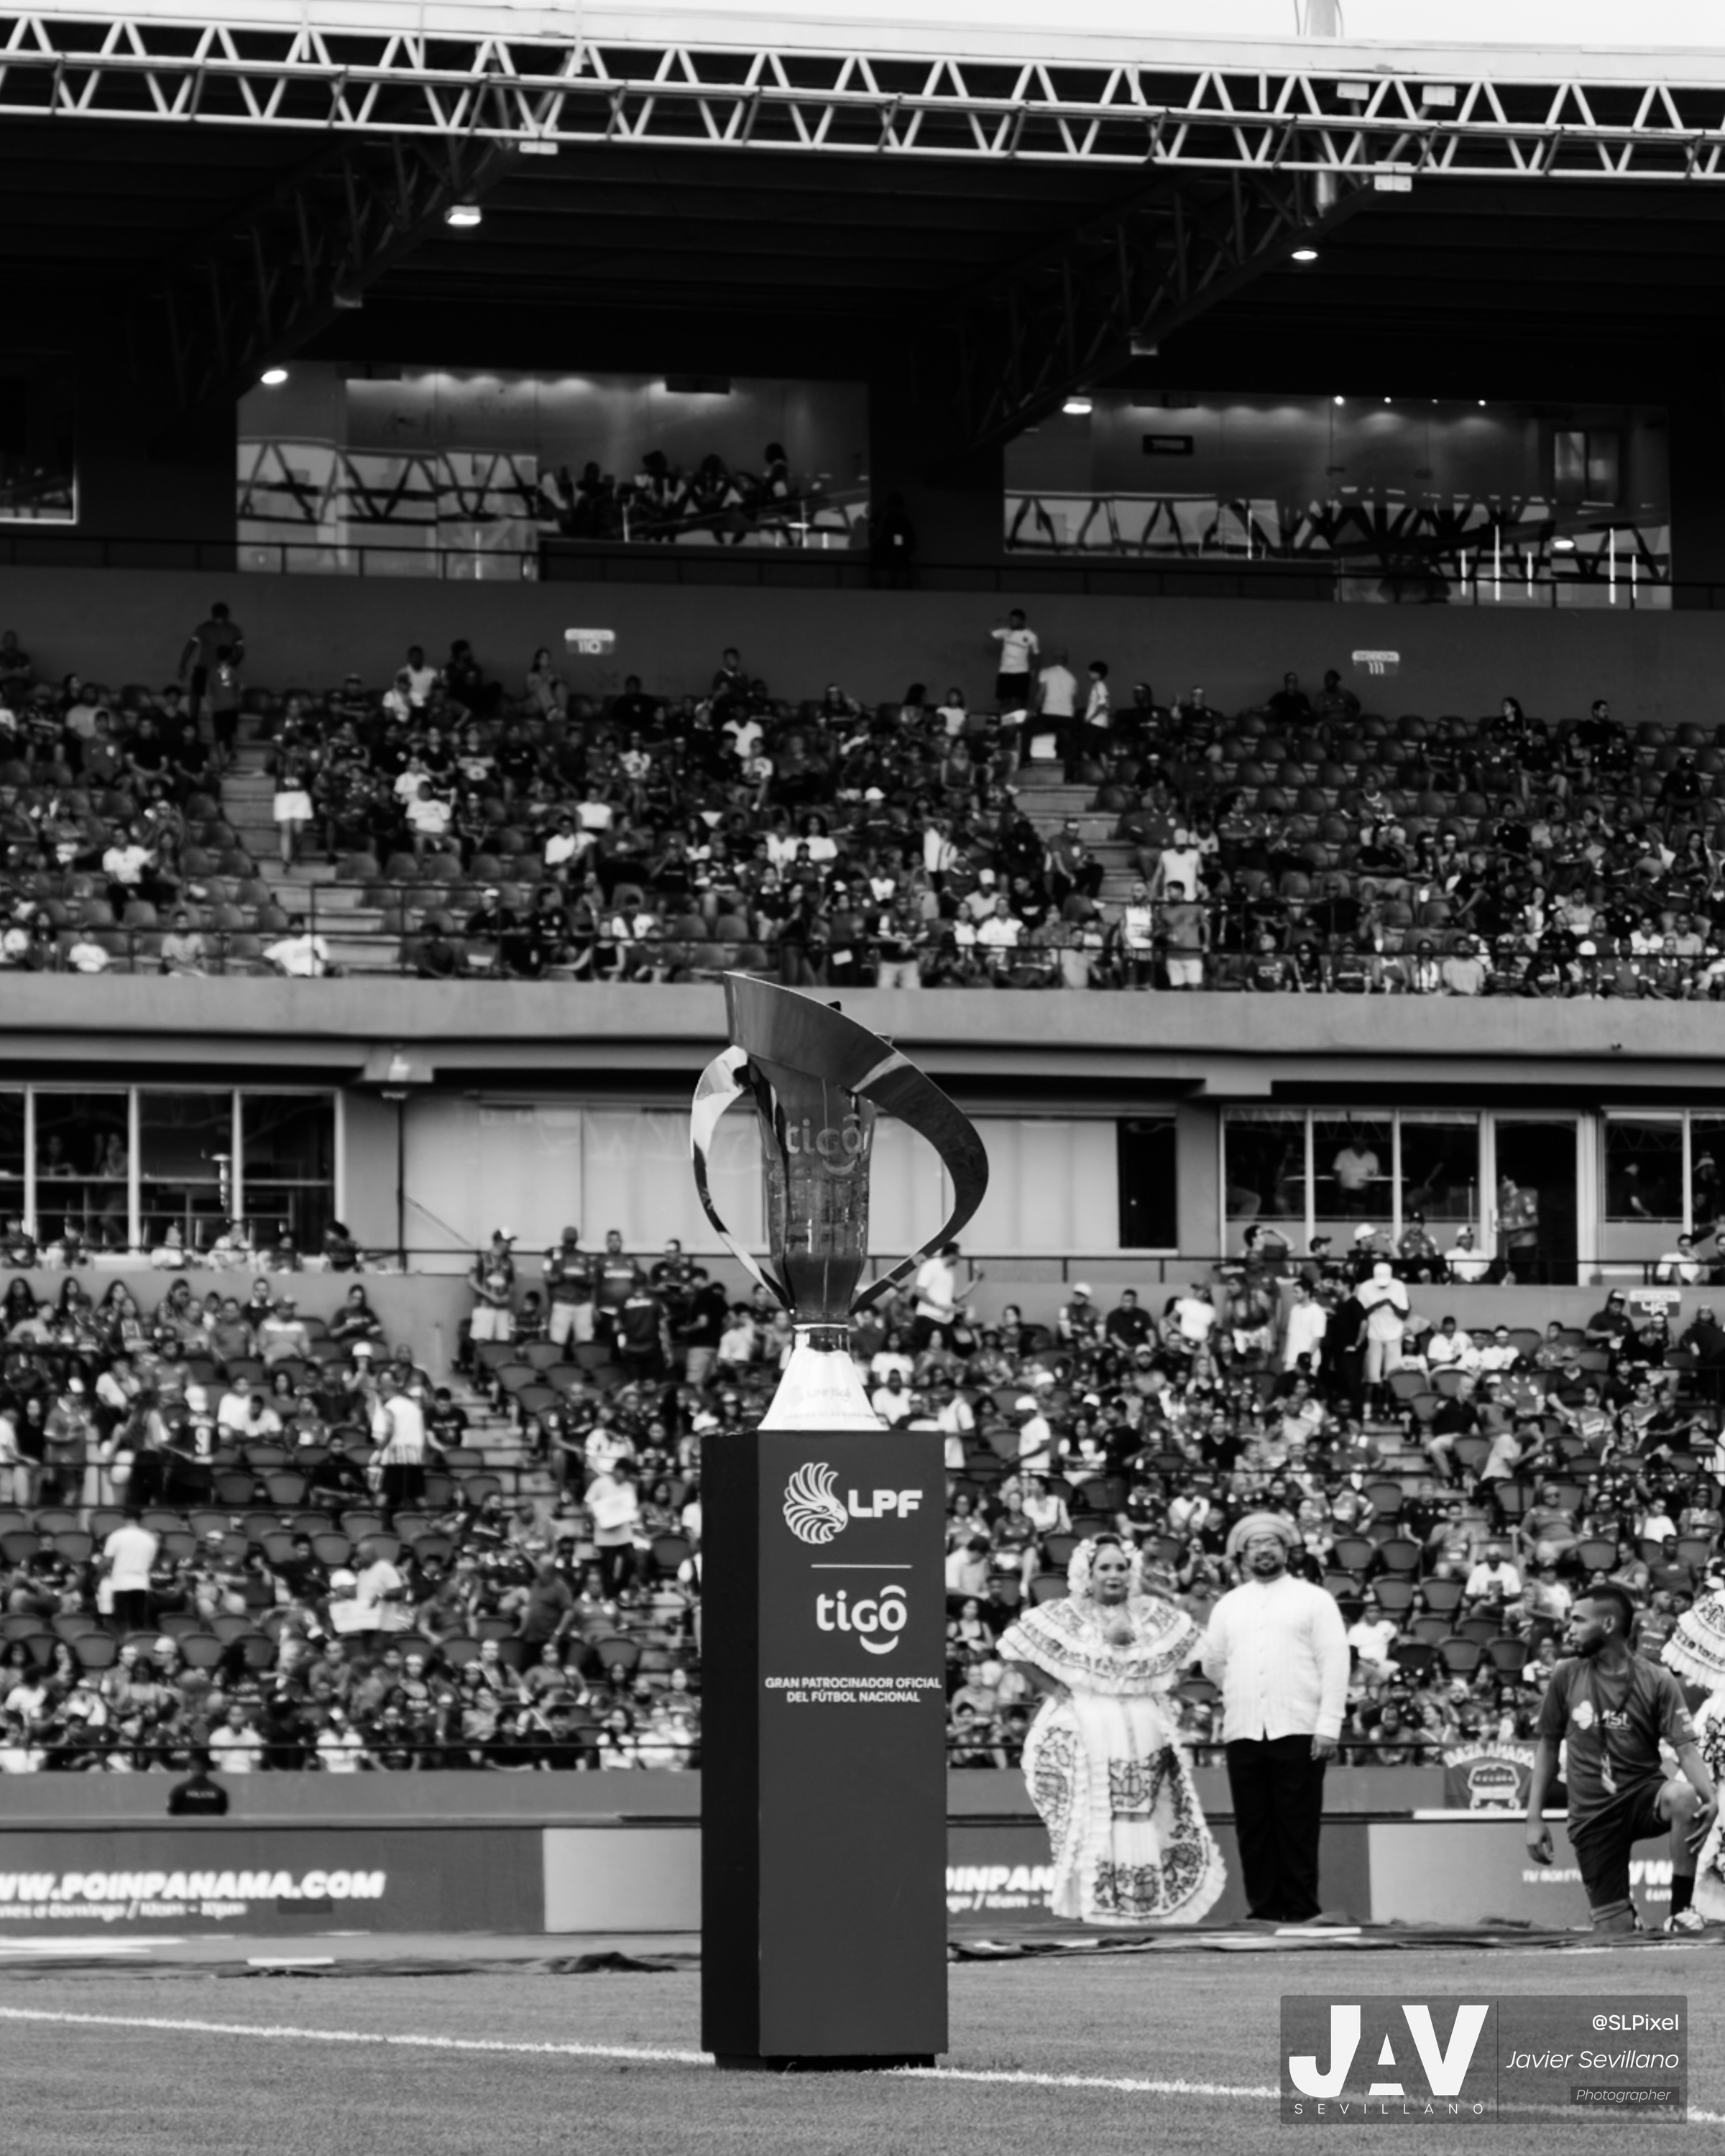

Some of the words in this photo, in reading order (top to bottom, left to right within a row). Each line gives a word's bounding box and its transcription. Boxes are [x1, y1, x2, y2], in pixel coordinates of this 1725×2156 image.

[578, 639, 602, 653] 110
[1368, 661, 1384, 674] 111
[848, 1489, 923, 1518] LPF
[765, 1677, 799, 1689] GRAN
[801, 1677, 893, 1689] PATROCINADOR
[896, 1677, 942, 1689] OFICIAL
[786, 1691, 809, 1703] DEL
[811, 1689, 856, 1703] FÚTBOL
[859, 1691, 921, 1703] NACIONAL
